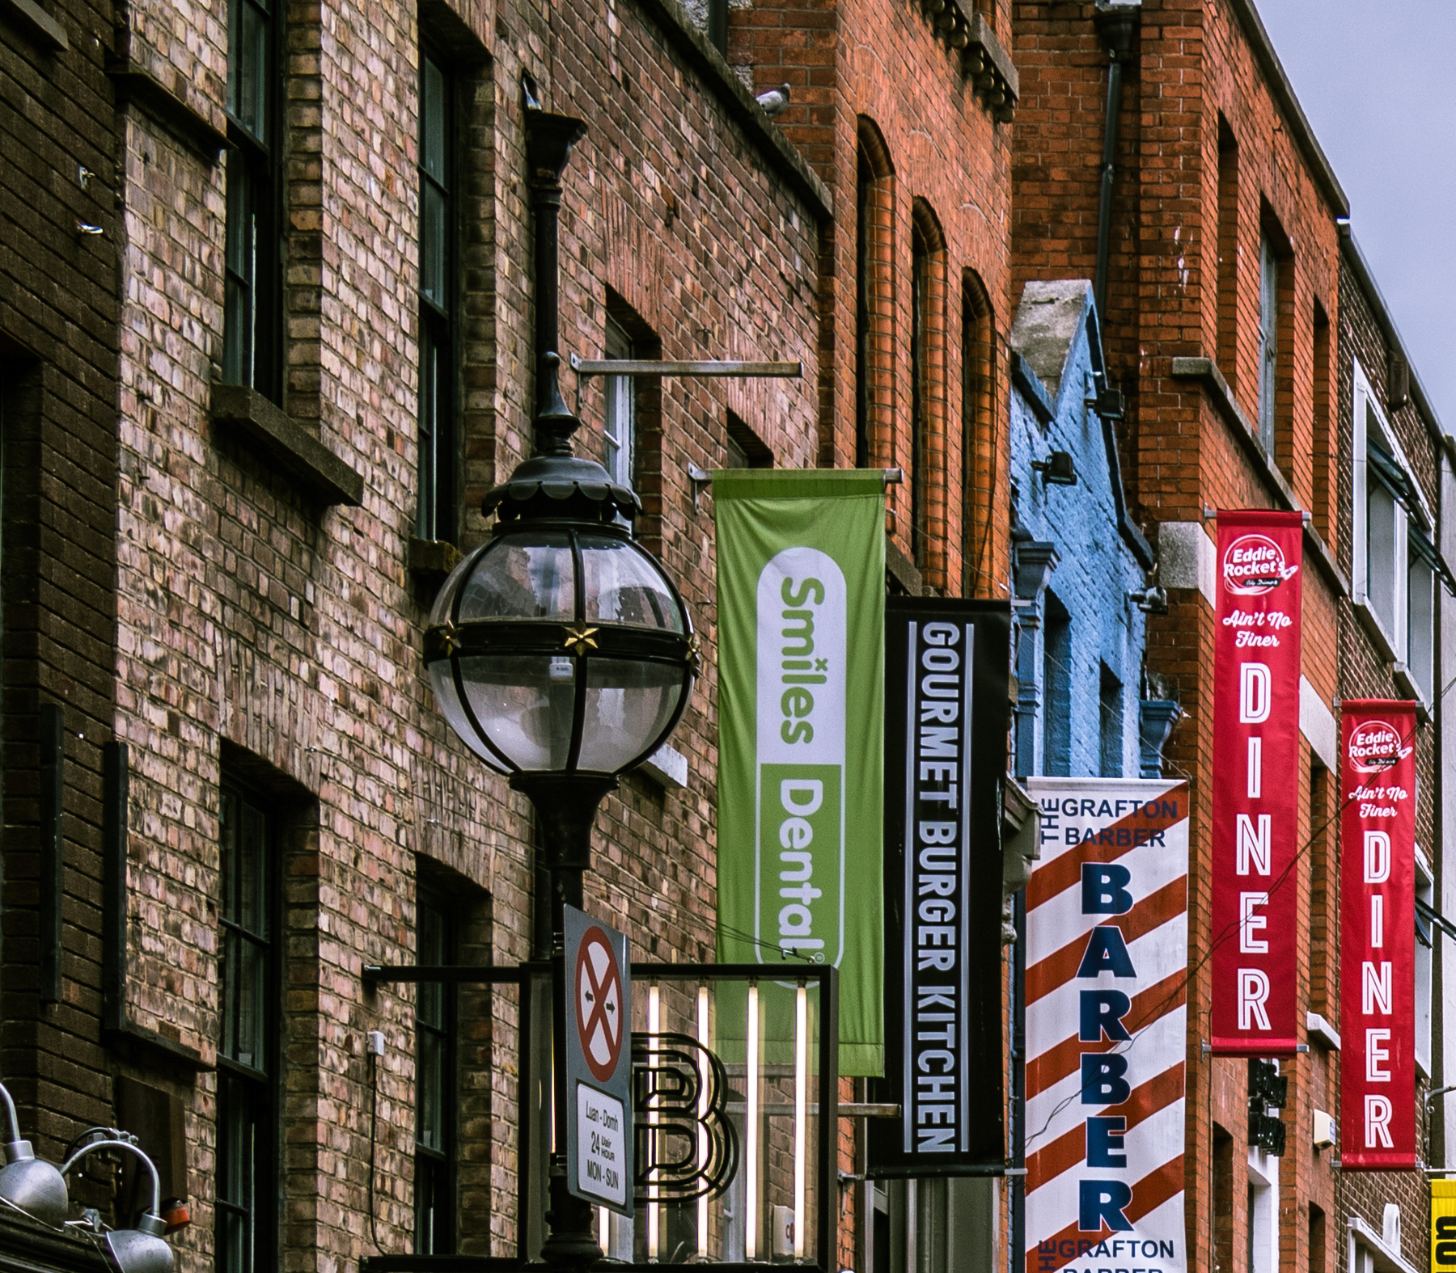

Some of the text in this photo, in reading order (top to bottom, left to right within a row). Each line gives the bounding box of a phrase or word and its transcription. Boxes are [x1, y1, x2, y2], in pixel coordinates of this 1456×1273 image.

[1233, 546, 1276, 563] Eddie
[1224, 558, 1286, 577] Rocket's
[1222, 610, 1292, 630] Ain't No
[1236, 630, 1280, 648] Finer
[780, 576, 829, 745] Smiles
[1356, 731, 1393, 746] Eddie
[1348, 785, 1408, 802] Ain't No
[1040, 796, 1178, 842] THE GRAFTON
[1359, 802, 1398, 818] Finer
[1064, 826, 1166, 849] BARBER
[1235, 661, 1271, 1032] DINER
[778, 779, 826, 950] Dental
[916, 620, 960, 1154] GOURMET BURGER KITCHEN
[1361, 830, 1392, 1149] DINER
[1076, 861, 1138, 1232] BARBER
[585, 1101, 600, 1123] Luan
[631, 1031, 739, 1203] B
[590, 1131, 600, 1156] 24
[601, 1150, 616, 1162] HOUR
[587, 1159, 619, 1190] MON SUN
[1059, 1239, 1174, 1259] GRAFTON
